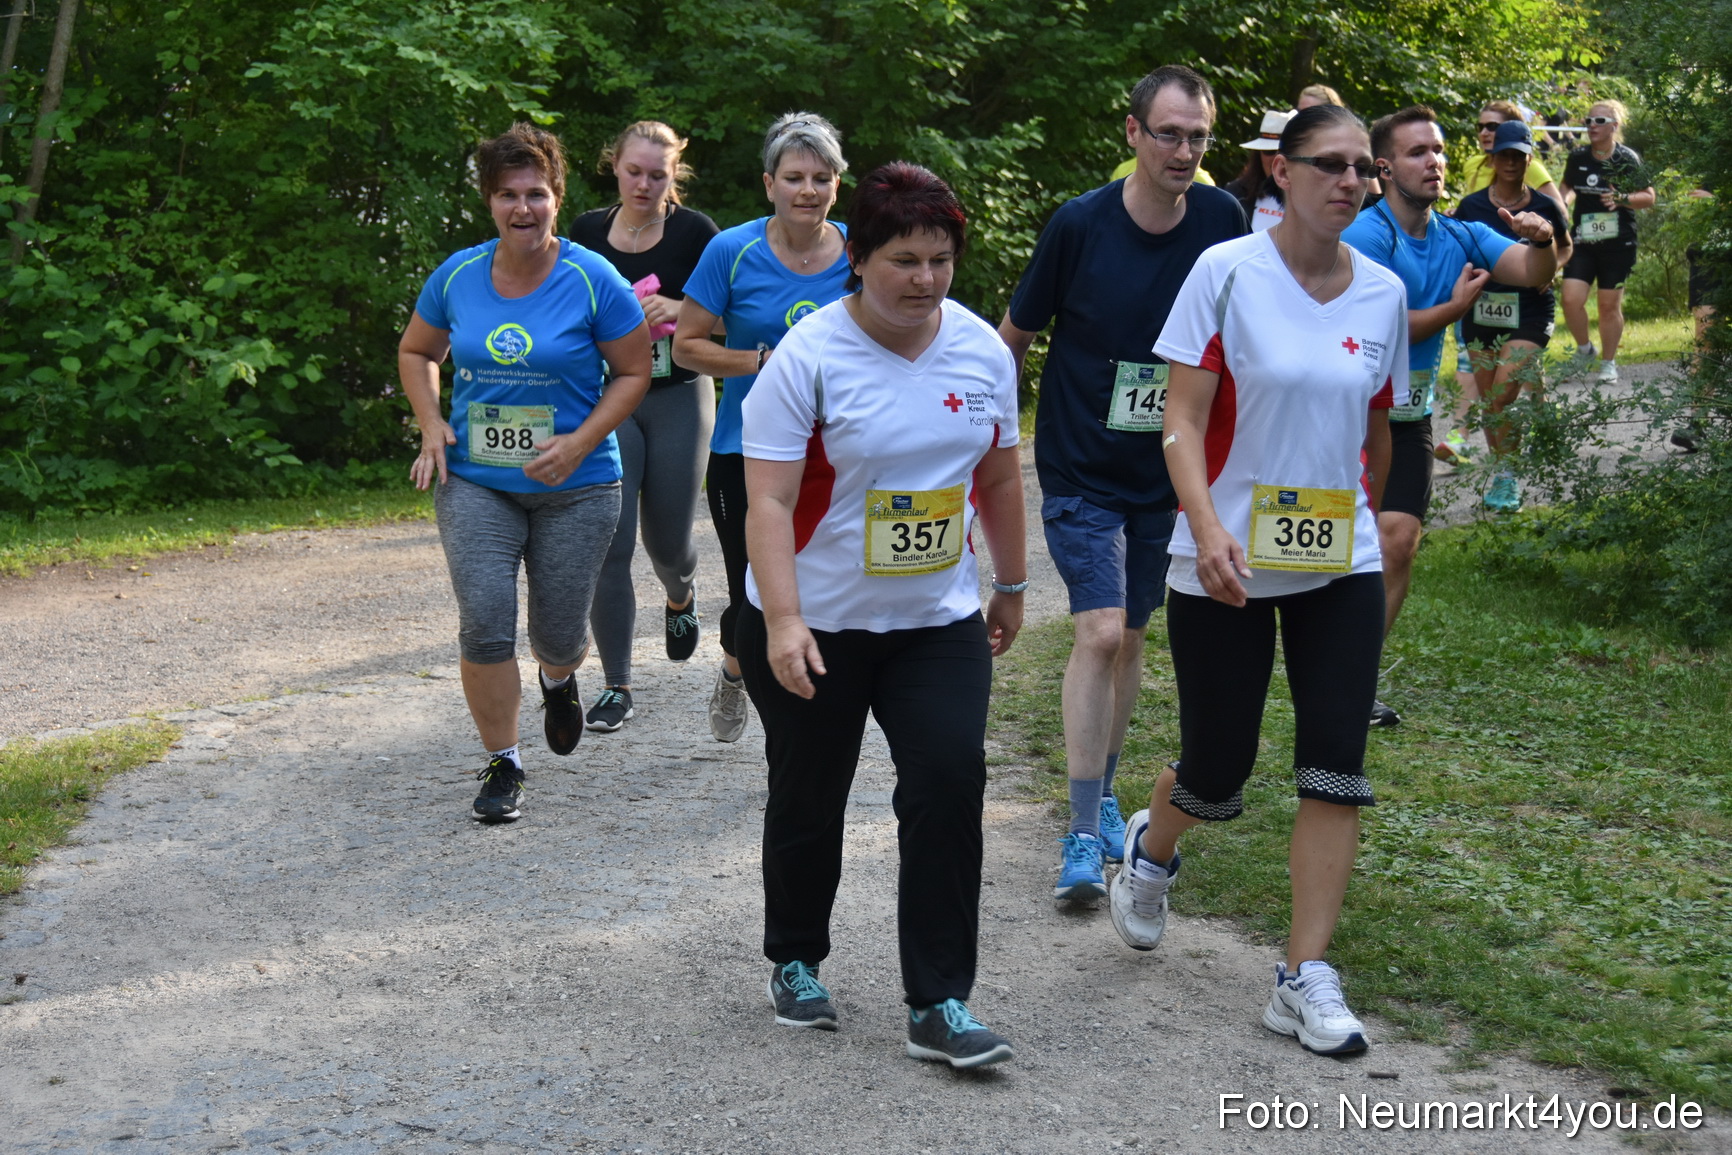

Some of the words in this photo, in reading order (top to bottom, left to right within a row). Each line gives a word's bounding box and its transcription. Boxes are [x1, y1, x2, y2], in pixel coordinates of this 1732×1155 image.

[1592, 222, 1606, 232] 96
[1478, 303, 1512, 318] 1440
[1363, 345, 1378, 353] Rotes
[477, 368, 548, 378] Handwerkskammer
[477, 376, 561, 387] Niederbayern-Oberpfalz
[485, 427, 533, 449] 988
[482, 448, 512, 456] Schneider
[883, 507, 929, 516] firmenlauf
[1270, 502, 1313, 512] firmenlauf
[891, 518, 950, 552] 357
[1274, 517, 1333, 548] 368
[893, 554, 924, 562] Bindler
[926, 550, 947, 559] Karola
[1281, 548, 1303, 556] Meier
